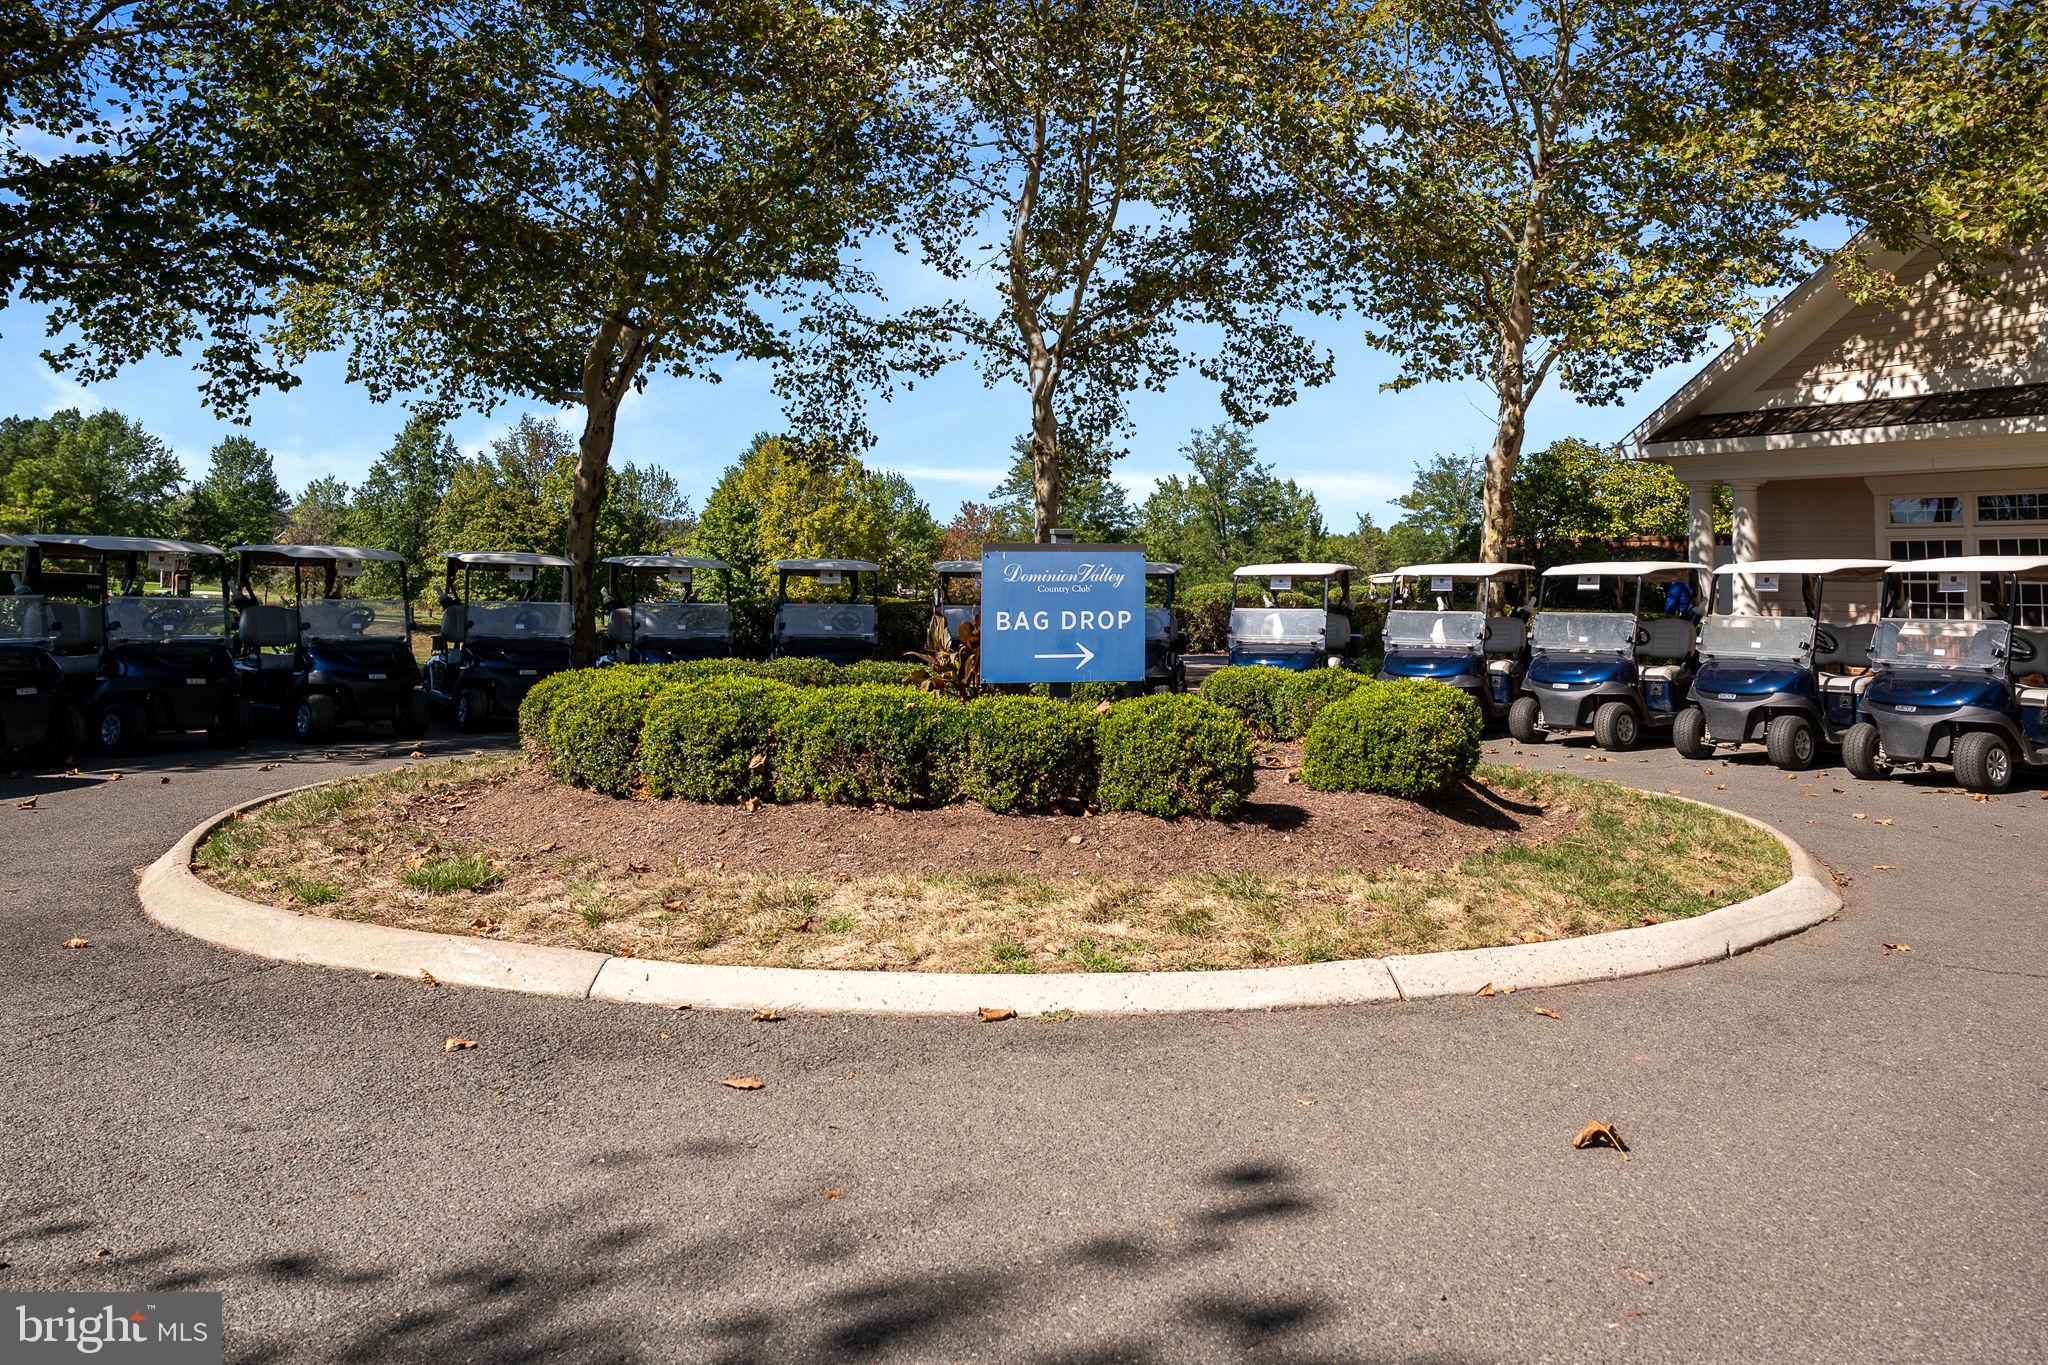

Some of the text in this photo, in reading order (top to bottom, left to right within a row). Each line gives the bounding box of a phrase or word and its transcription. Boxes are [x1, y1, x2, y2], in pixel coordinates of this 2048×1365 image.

[1003, 563, 1126, 588] Dominion Valley
[1037, 584, 1070, 593] Country
[996, 610, 1132, 631] BAG DROP
